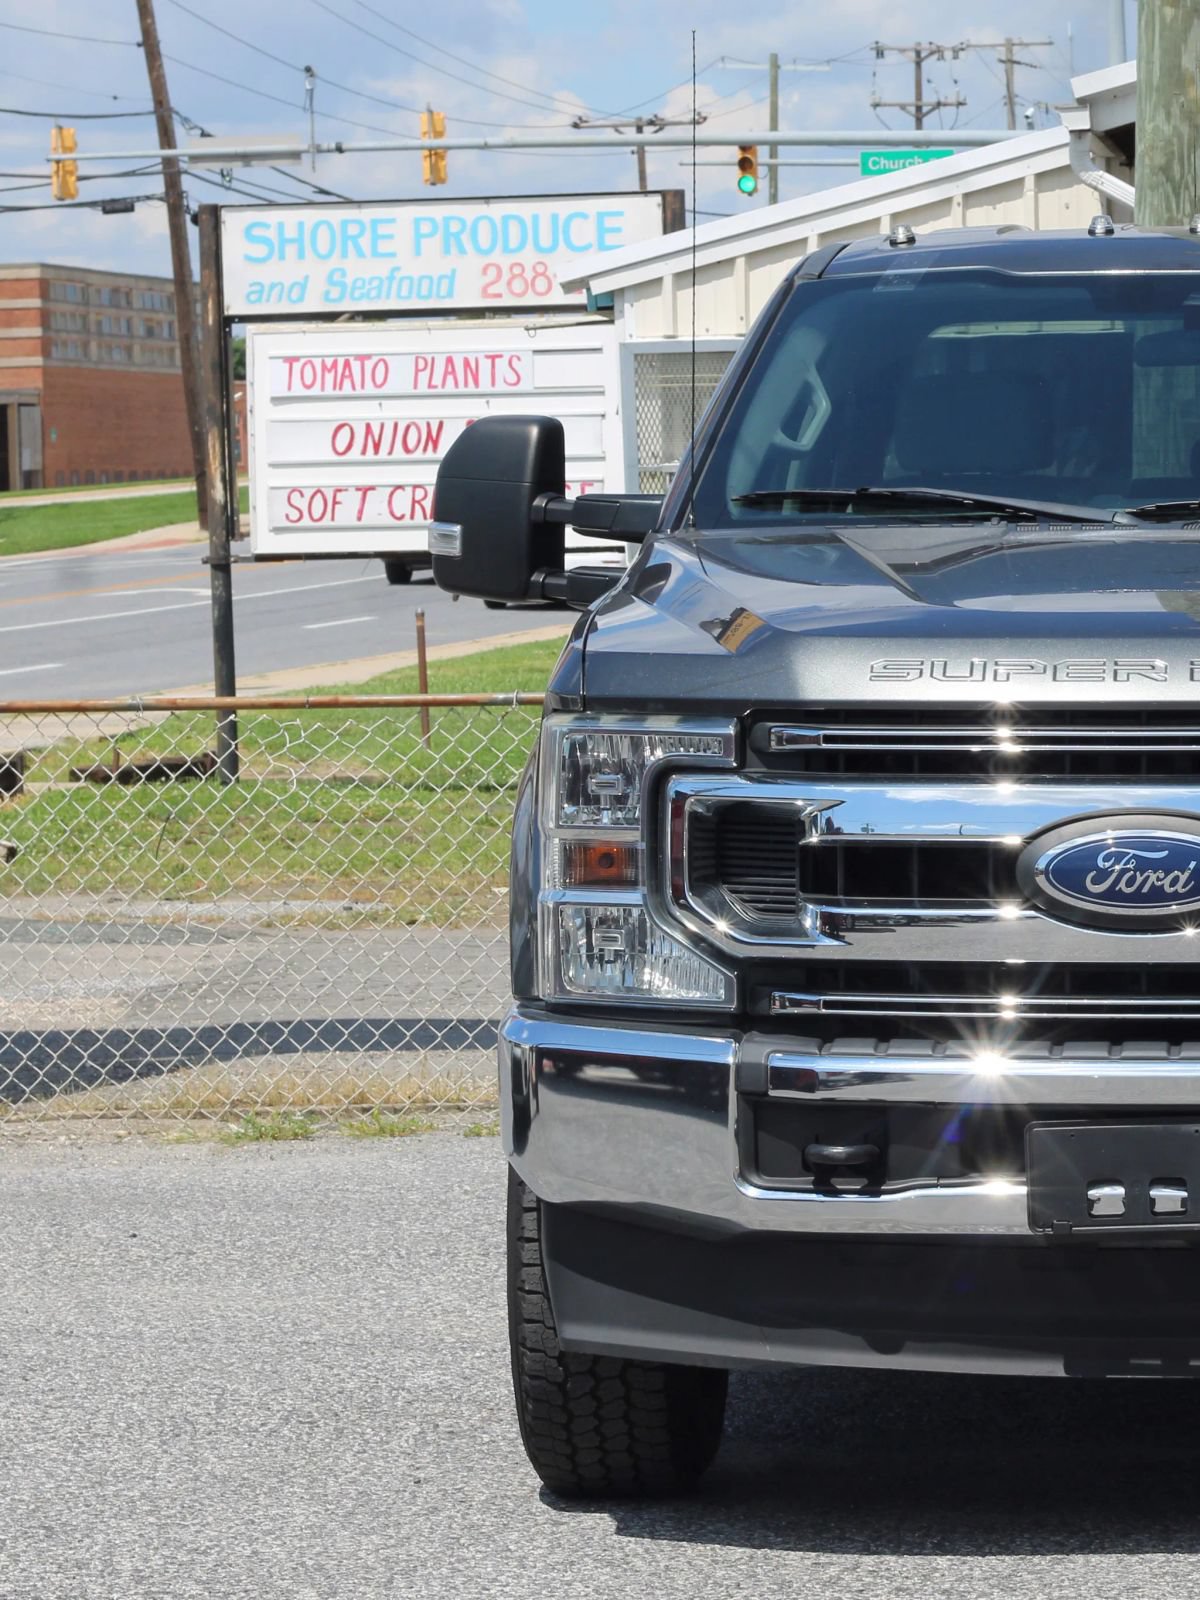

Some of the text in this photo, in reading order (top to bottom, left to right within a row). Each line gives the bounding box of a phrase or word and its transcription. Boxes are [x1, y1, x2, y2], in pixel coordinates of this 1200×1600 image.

[868, 156, 922, 170] Church
[243, 210, 625, 264] SHORE PRODUCE
[246, 277, 307, 304] and
[324, 265, 456, 303] Seafood
[283, 354, 522, 392] TOMATO PLANTS
[331, 420, 444, 456] ONION
[285, 485, 434, 523] SOFT CR
[868, 658, 1168, 682] SUPER
[1085, 848, 1197, 894] Ford
